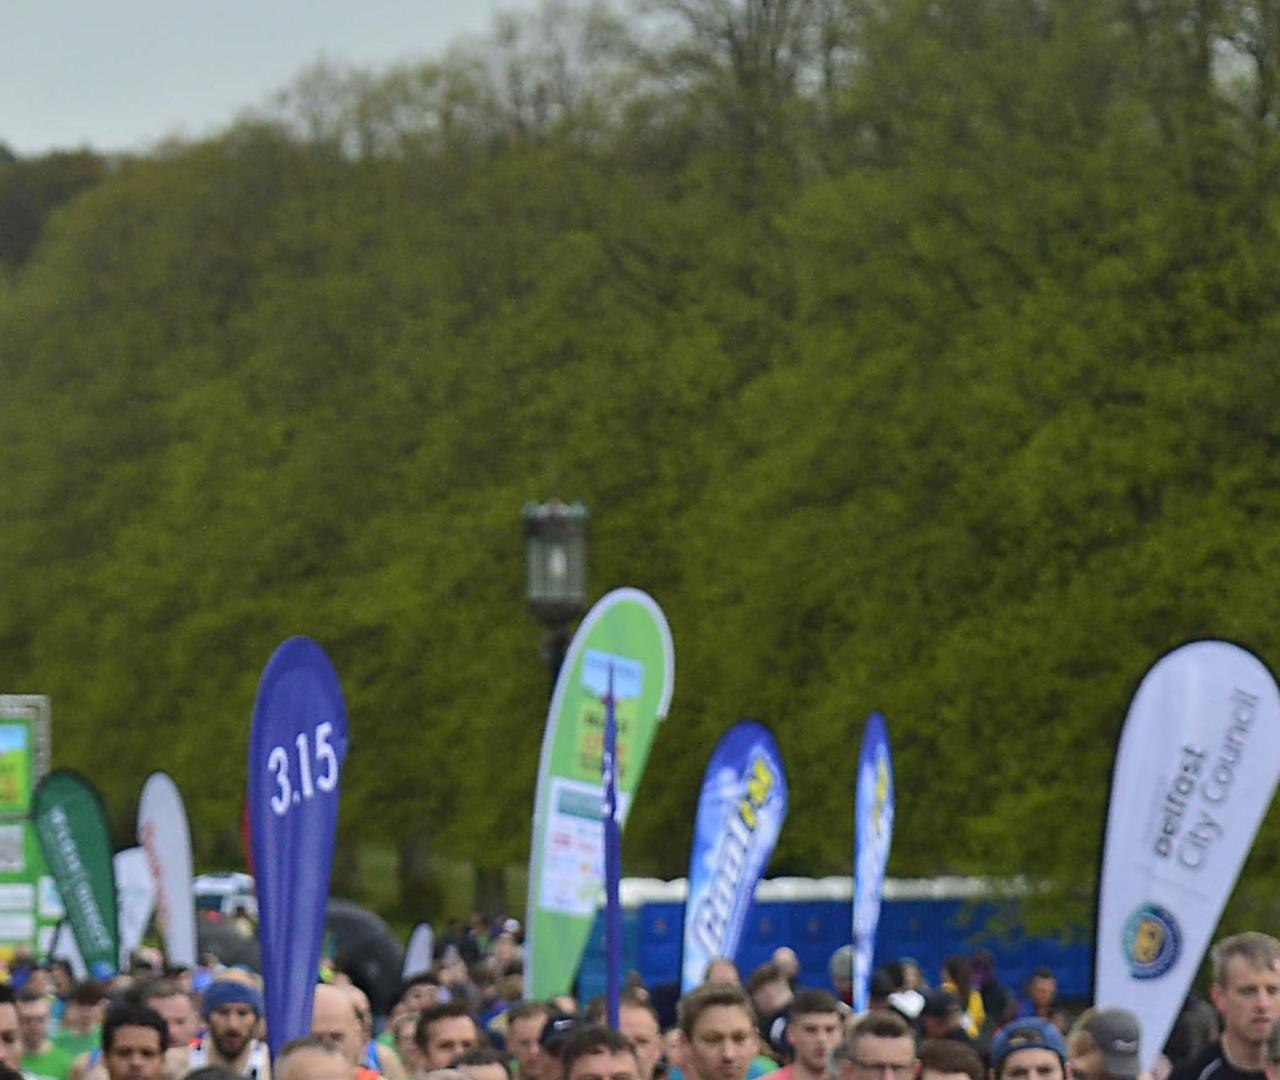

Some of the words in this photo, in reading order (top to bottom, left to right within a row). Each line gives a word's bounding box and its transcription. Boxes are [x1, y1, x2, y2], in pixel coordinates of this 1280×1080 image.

[267, 721, 338, 816] 3.15
[1177, 811, 1225, 871] City
[1203, 687, 1259, 803] Council
